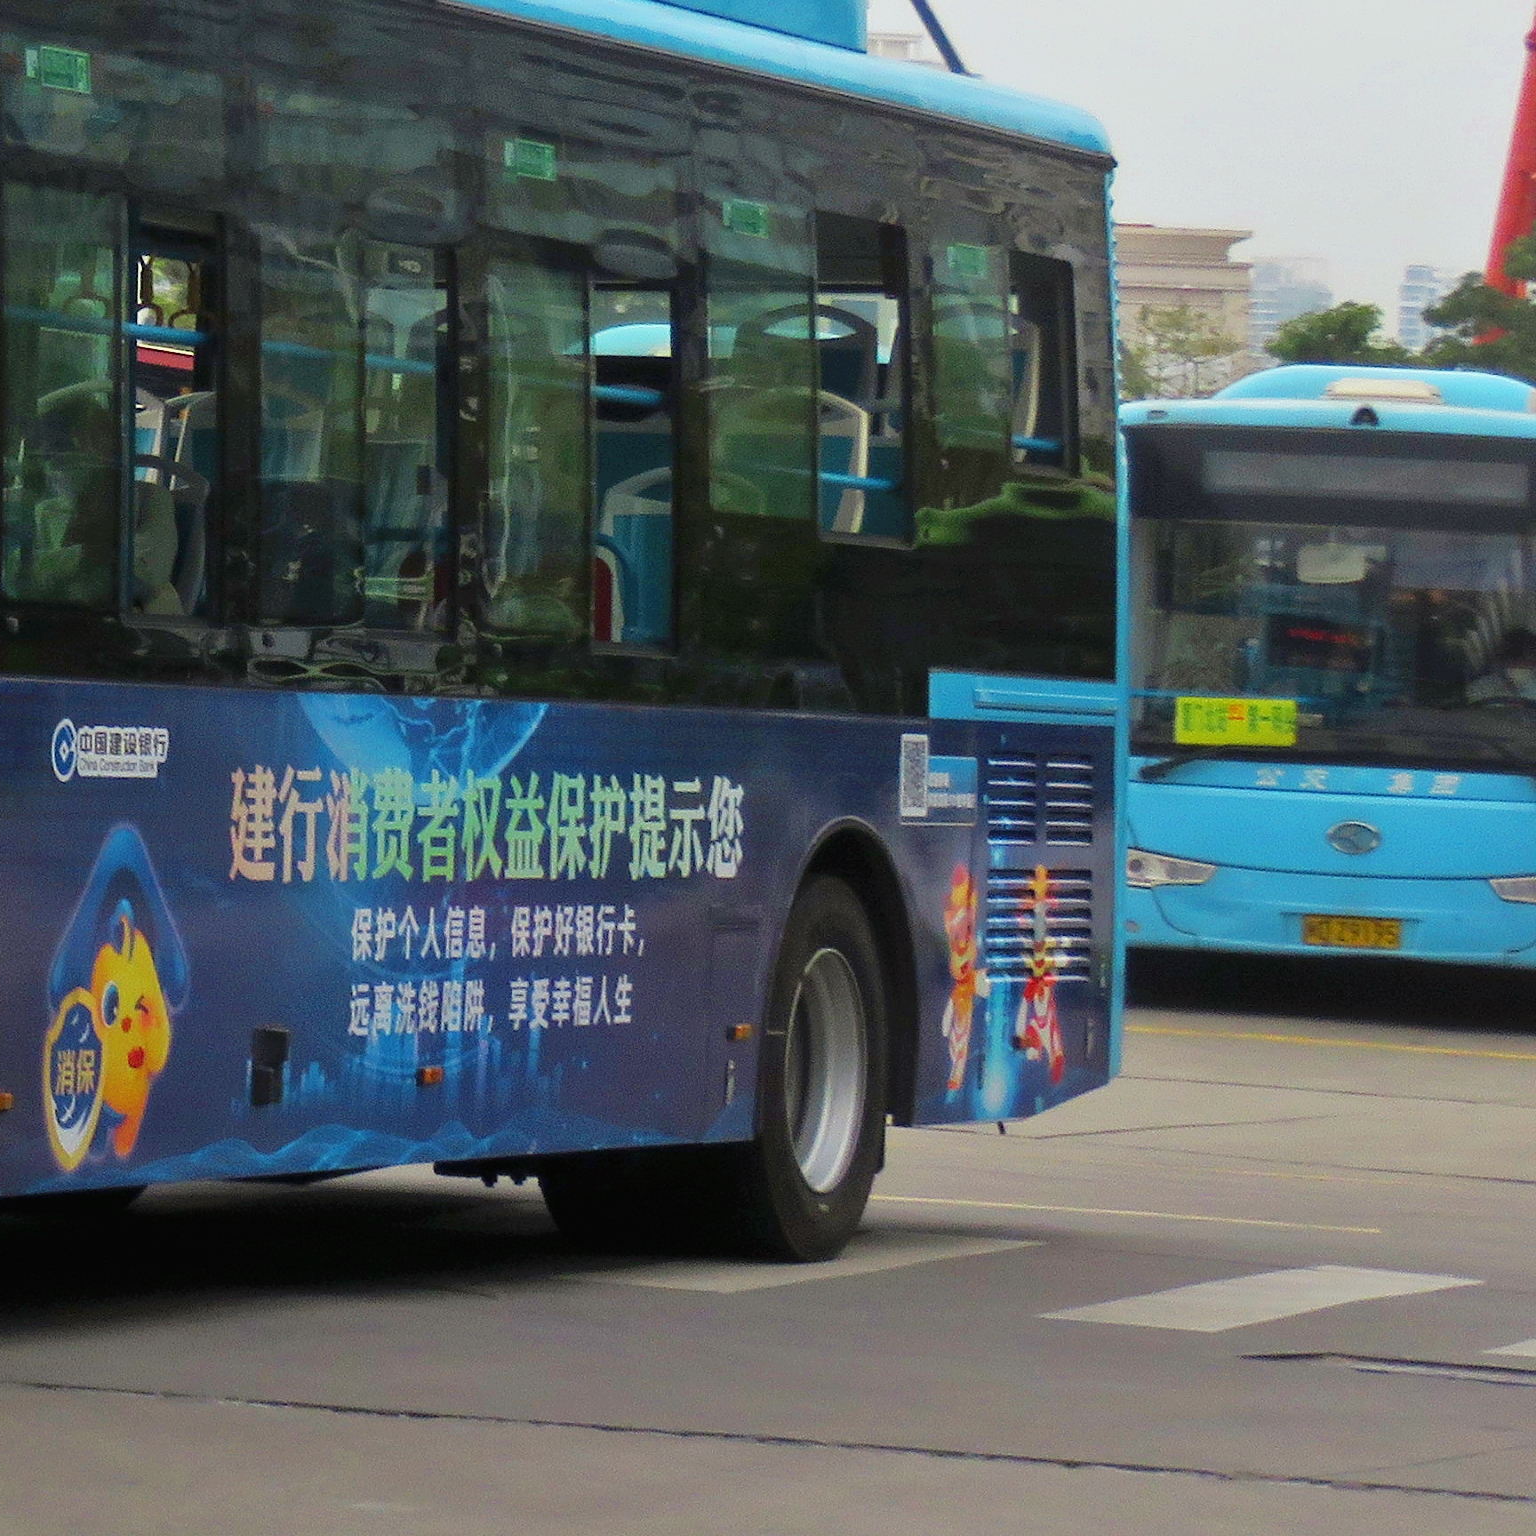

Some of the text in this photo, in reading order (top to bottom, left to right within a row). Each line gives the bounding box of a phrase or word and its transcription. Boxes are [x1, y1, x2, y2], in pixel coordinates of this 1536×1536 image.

[79, 731, 167, 758] 中国建设银行
[229, 764, 745, 882] 建行消费者权益保护提示您
